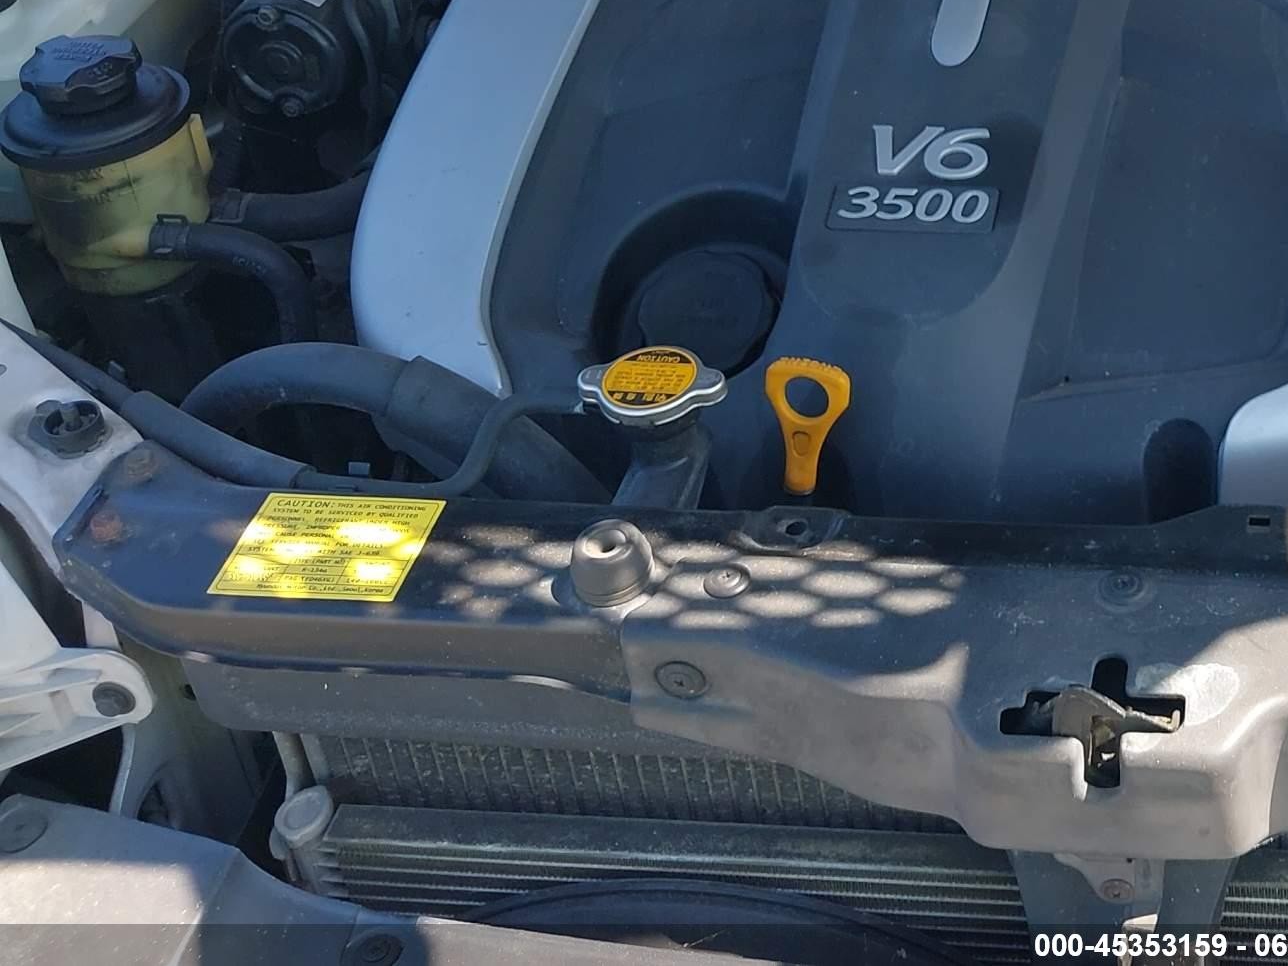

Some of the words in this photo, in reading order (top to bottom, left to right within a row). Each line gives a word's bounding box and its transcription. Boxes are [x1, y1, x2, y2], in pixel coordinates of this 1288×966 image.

[872, 124, 990, 180] V6
[837, 186, 989, 223] 3500
[637, 354, 681, 363] CAUTION
[277, 499, 335, 508] CAUTION:
